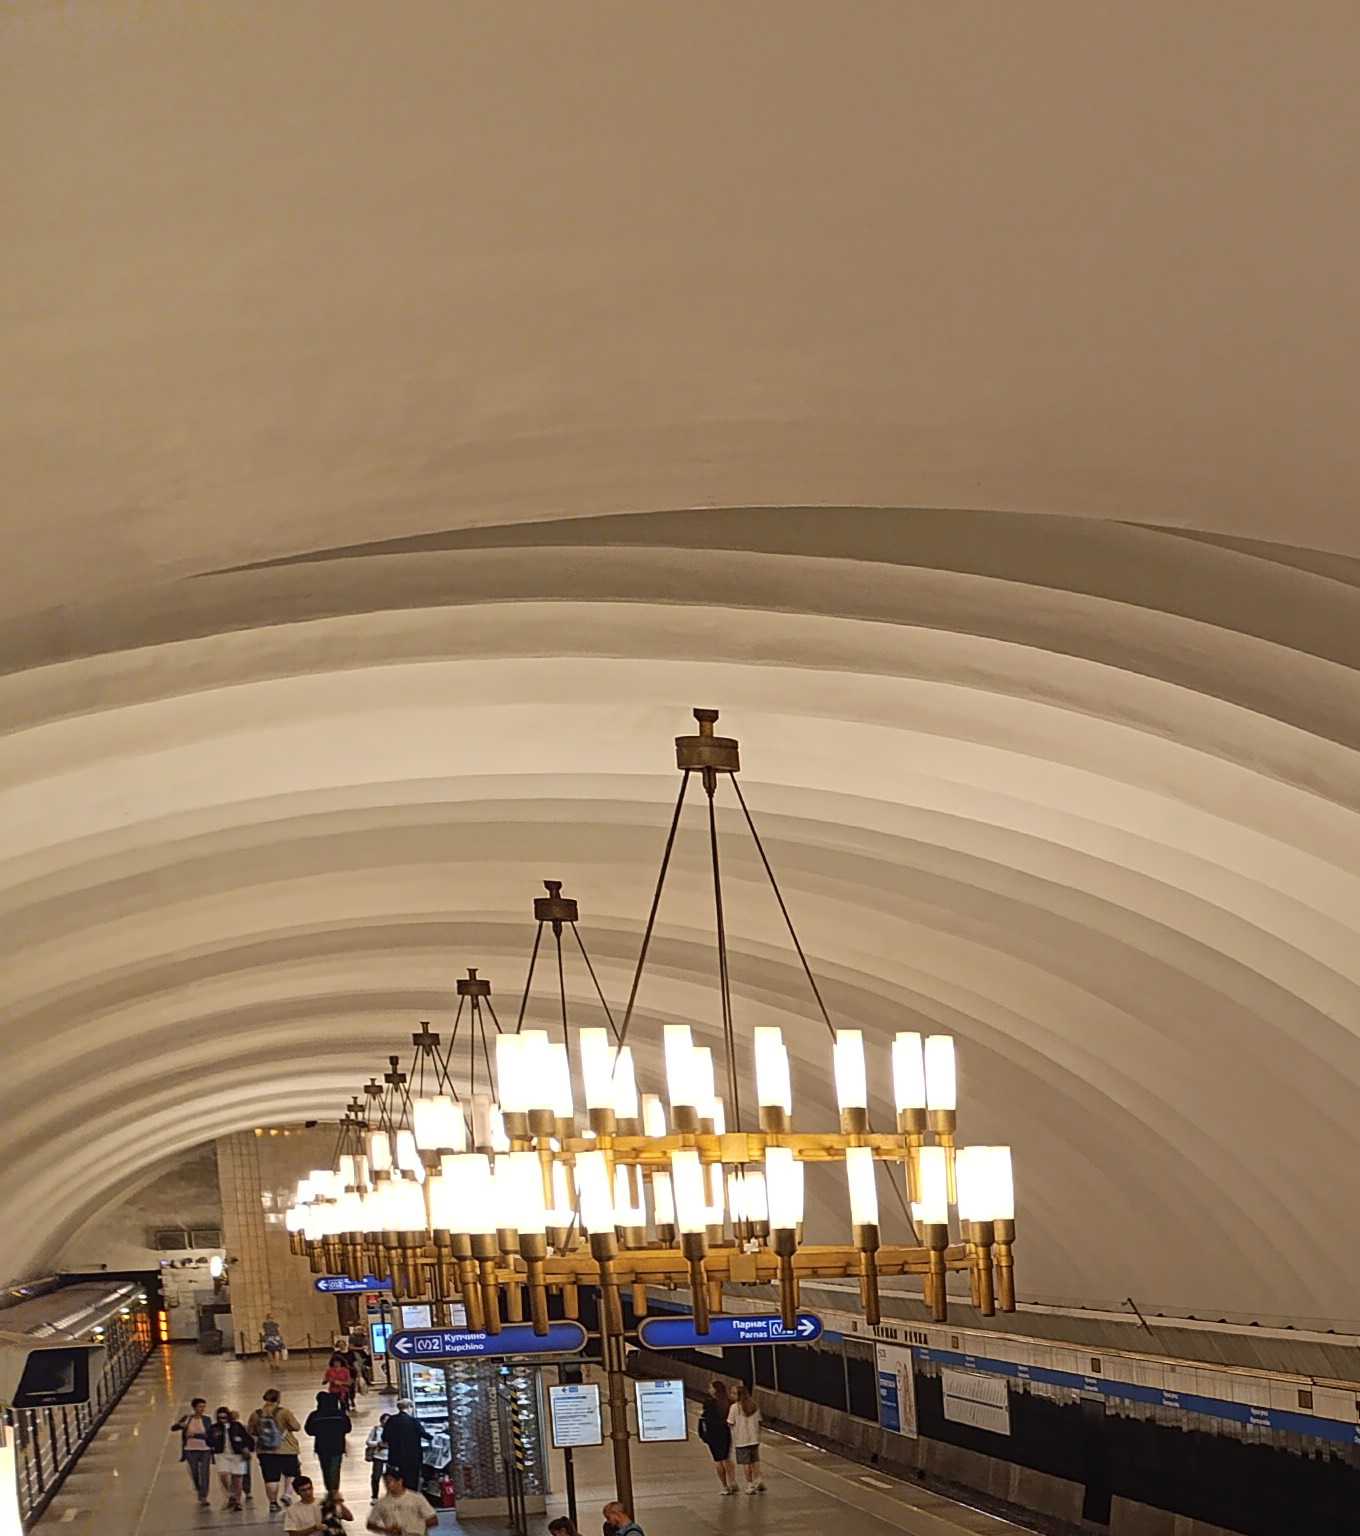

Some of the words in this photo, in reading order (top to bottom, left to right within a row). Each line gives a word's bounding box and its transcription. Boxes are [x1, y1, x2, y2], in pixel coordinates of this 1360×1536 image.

[733, 1320, 767, 1329] Парнас
[444, 1333, 486, 1343] Купчино
[740, 1331, 767, 1339] Parnas
[445, 1343, 484, 1352] Kupchino
